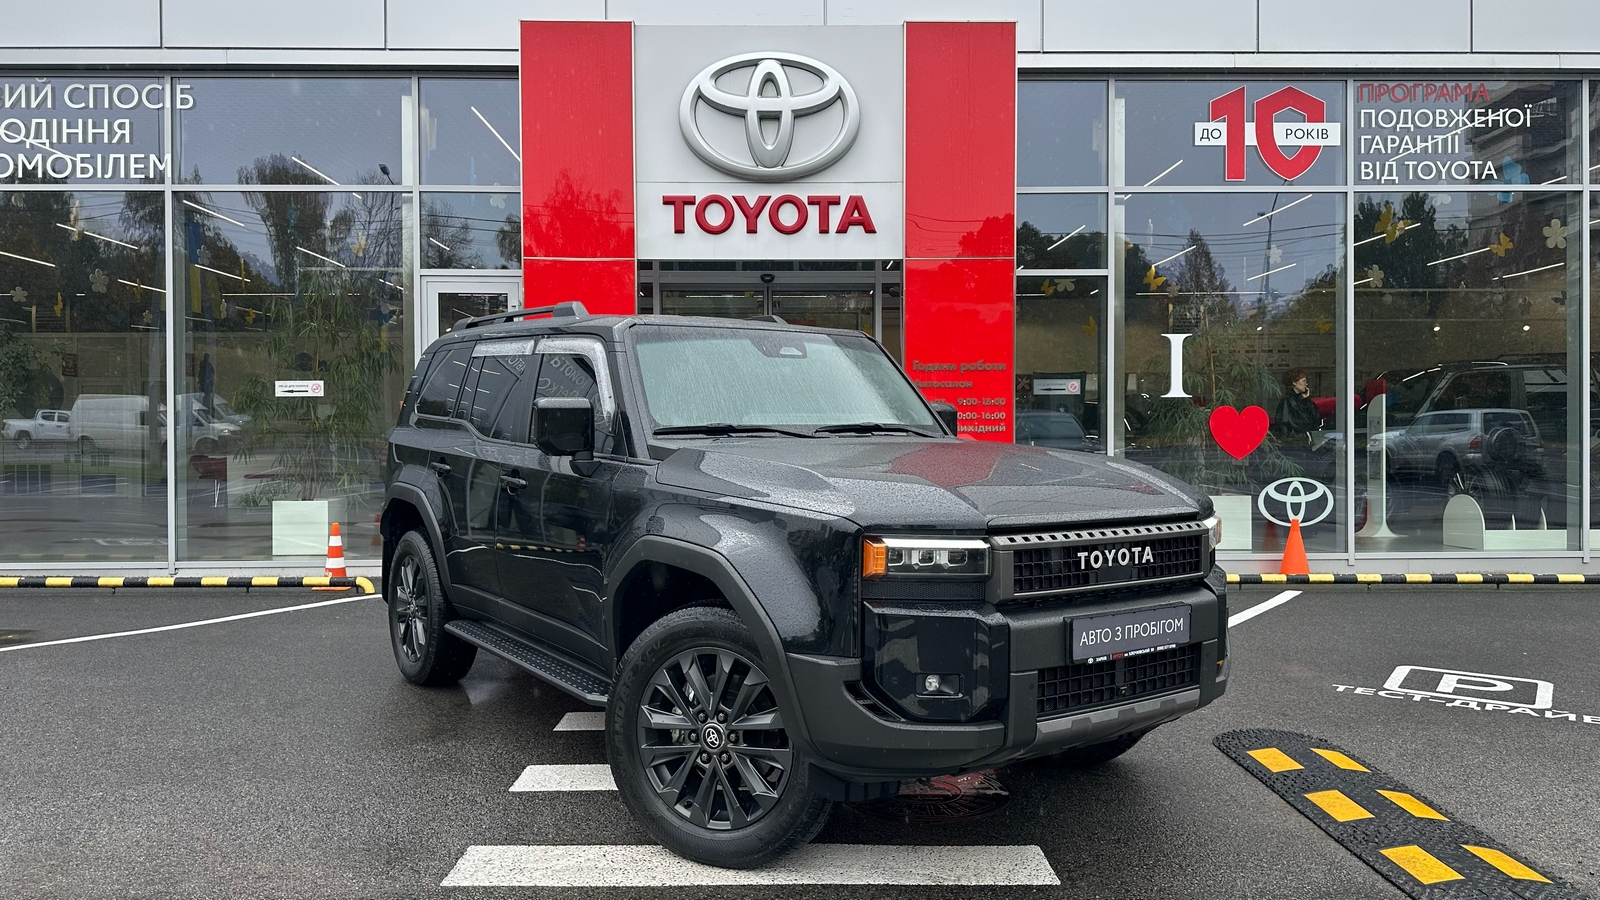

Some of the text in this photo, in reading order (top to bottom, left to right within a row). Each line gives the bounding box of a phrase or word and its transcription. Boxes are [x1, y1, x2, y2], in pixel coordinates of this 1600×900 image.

[63, 83, 194, 109] СПОСІБ
[1359, 83, 1490, 102] ПРОГРАМА
[1360, 104, 1532, 130] ПОДОВЖЕНОЇ
[1, 118, 130, 148] ОДІННЯ
[1200, 85, 1329, 182] ДО 10 РОКІВ
[1360, 130, 1460, 154] ГАРАНТІЇ
[1360, 160, 1498, 184] ВІД TOYOTA
[662, 194, 877, 235] TOYOTA
[912, 359, 1007, 374] Години роботи
[914, 379, 973, 389] Автосалон
[957, 412, 1007, 420] 0:00-16:00
[1077, 546, 1154, 570] TOYOTA
[1080, 627, 1112, 647] АВТО
[1125, 618, 1184, 640] ПРОБІГОМ
[1436, 673, 1514, 694] P
